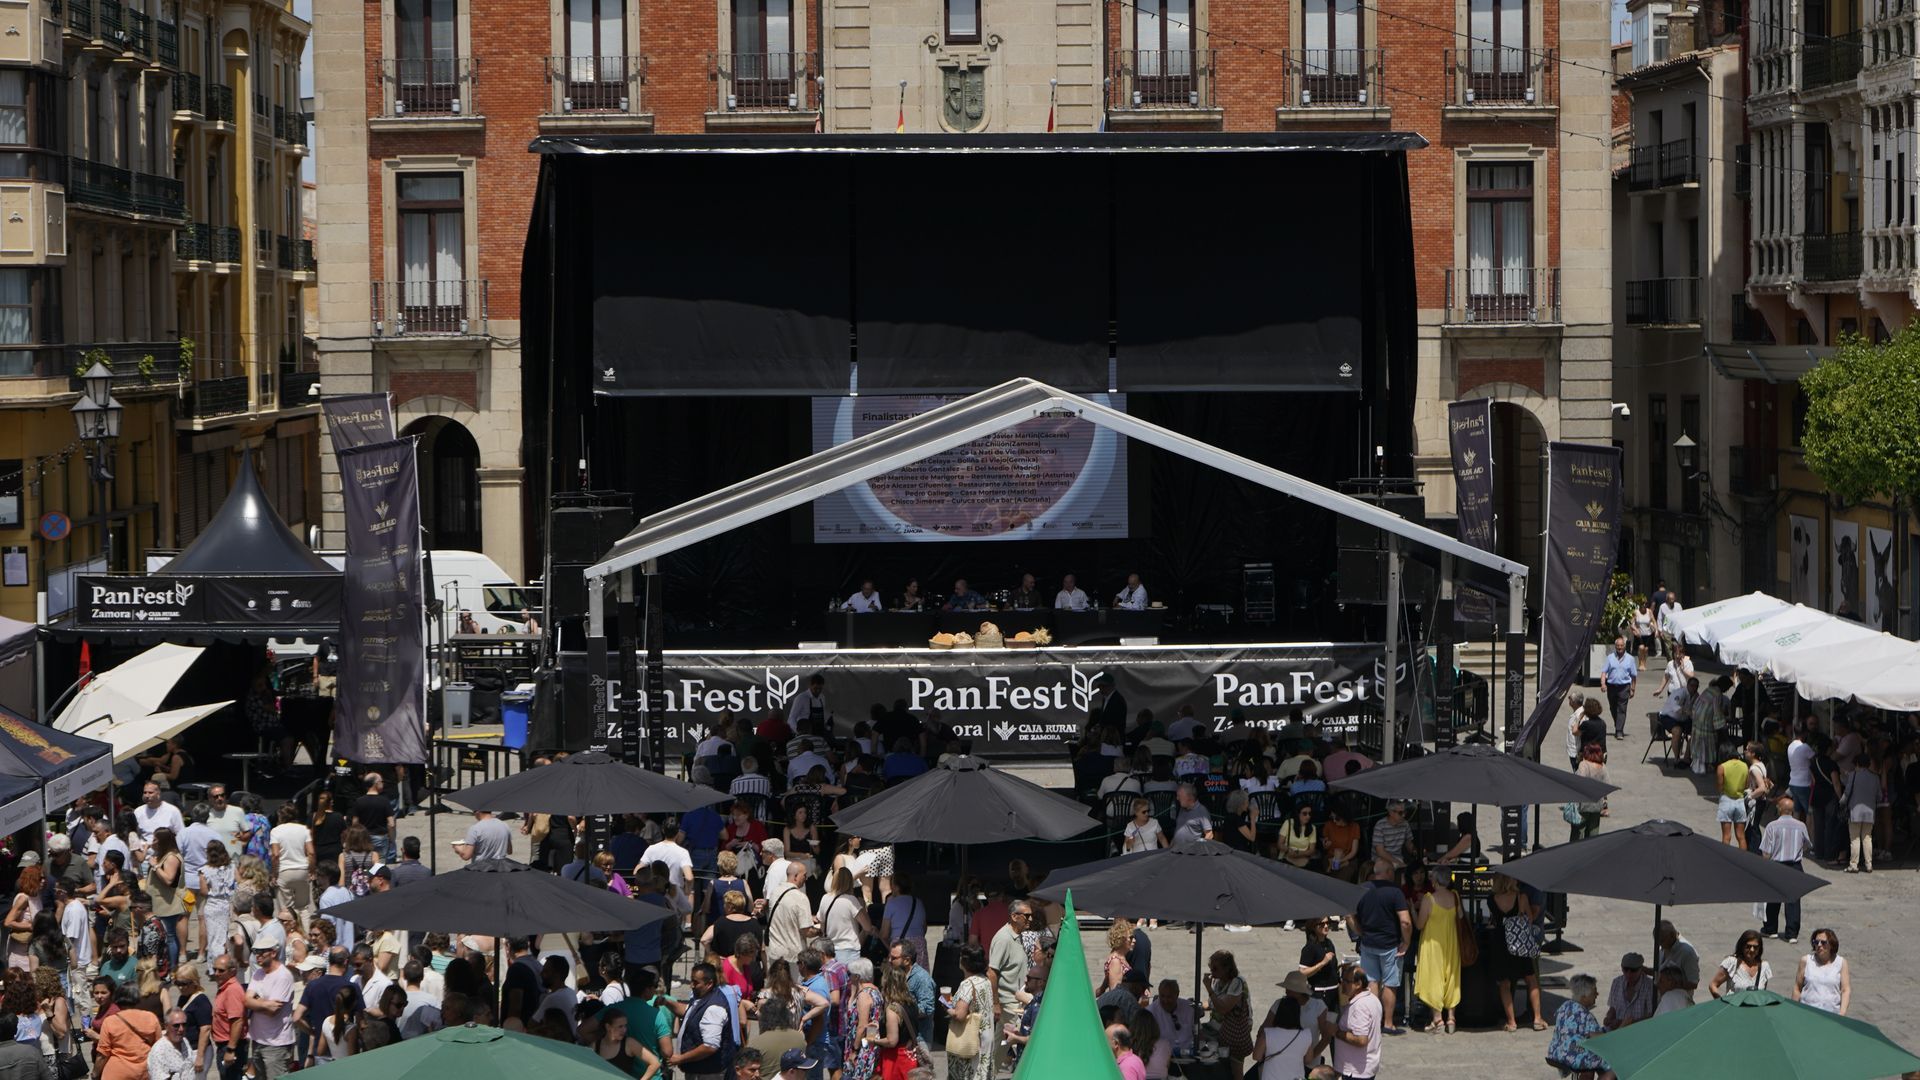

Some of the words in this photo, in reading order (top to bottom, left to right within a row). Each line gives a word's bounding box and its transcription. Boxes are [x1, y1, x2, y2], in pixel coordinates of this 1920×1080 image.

[862, 412, 909, 421] Finalistas
[91, 586, 174, 605] PanFest
[91, 608, 131, 618] Zamora
[908, 676, 1067, 711] PanFest
[1213, 671, 1370, 706] PanFest
[1322, 716, 1346, 725] CAJA
[1019, 724, 1043, 733] CAJA
